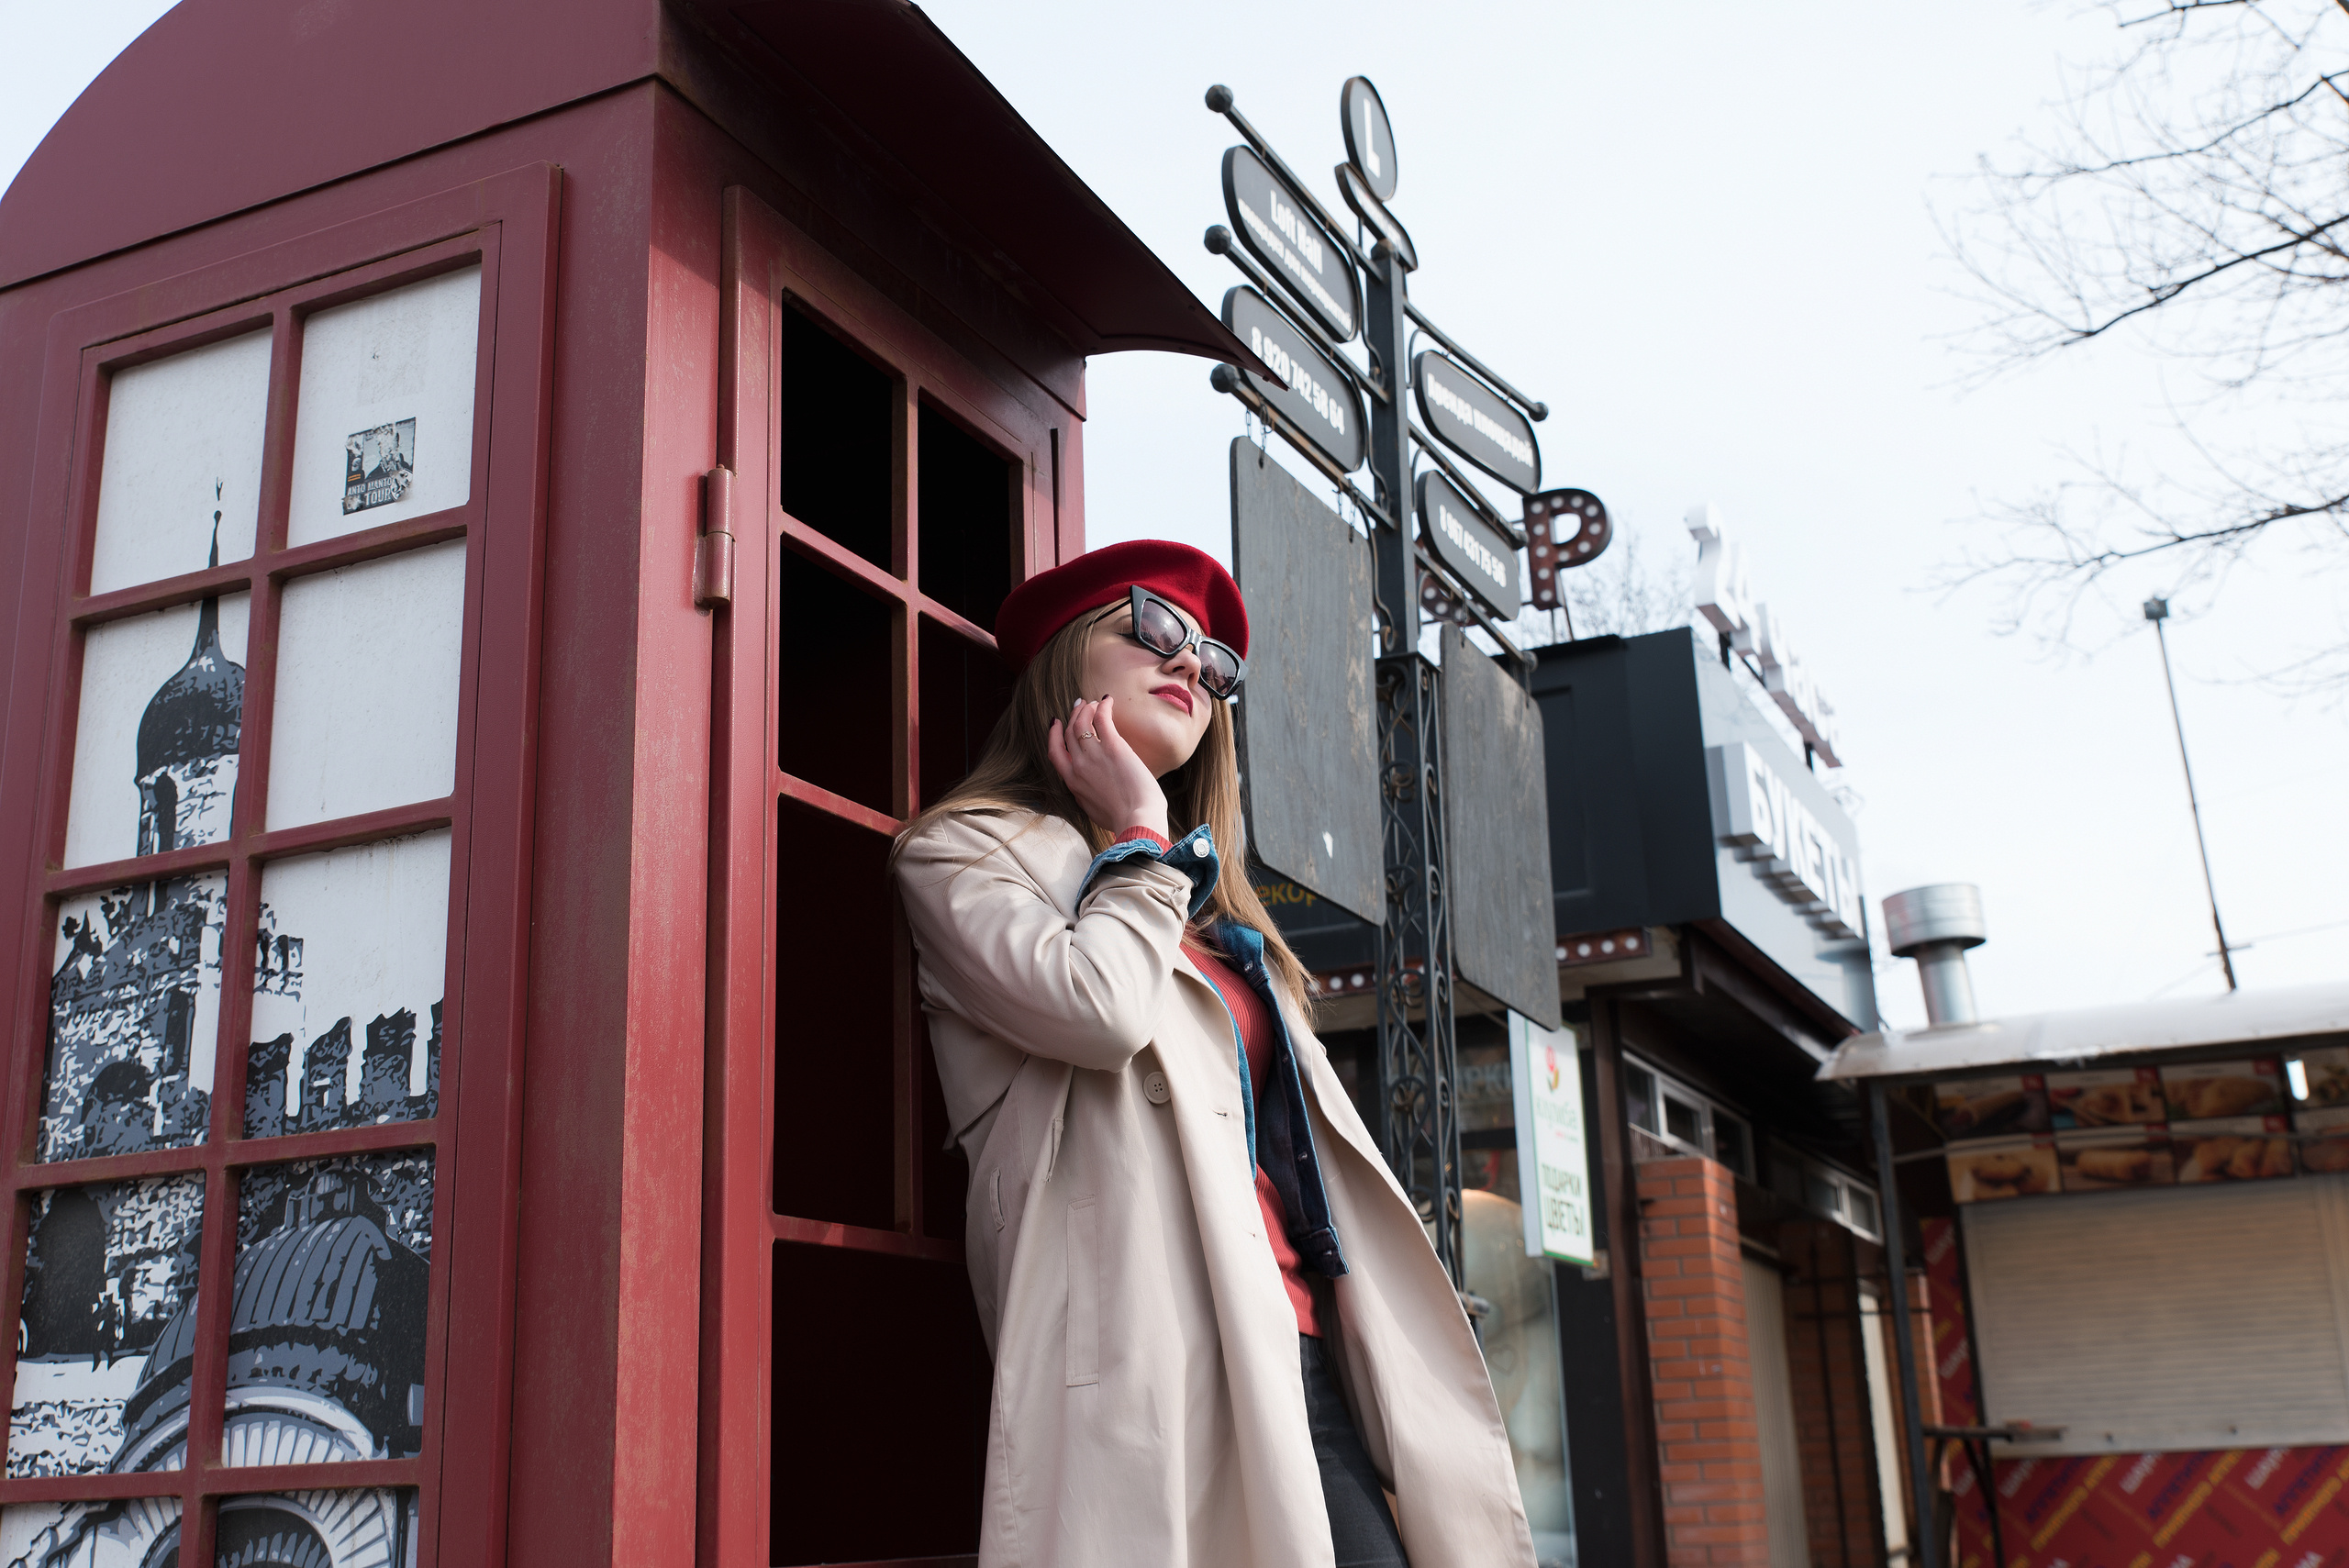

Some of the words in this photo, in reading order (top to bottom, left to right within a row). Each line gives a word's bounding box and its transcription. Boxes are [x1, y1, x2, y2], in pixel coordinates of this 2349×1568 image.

[1270, 189, 1297, 246] Loft
[1297, 218, 1322, 274] Hall
[1251, 326, 1263, 359] 8
[1263, 336, 1291, 384] 920
[1290, 359, 1313, 405] 742
[364, 487, 393, 506] TOUR
[1741, 740, 1865, 940] БУКЕТЫ
[1544, 1195, 1586, 1238] ЦВЕТЫ
